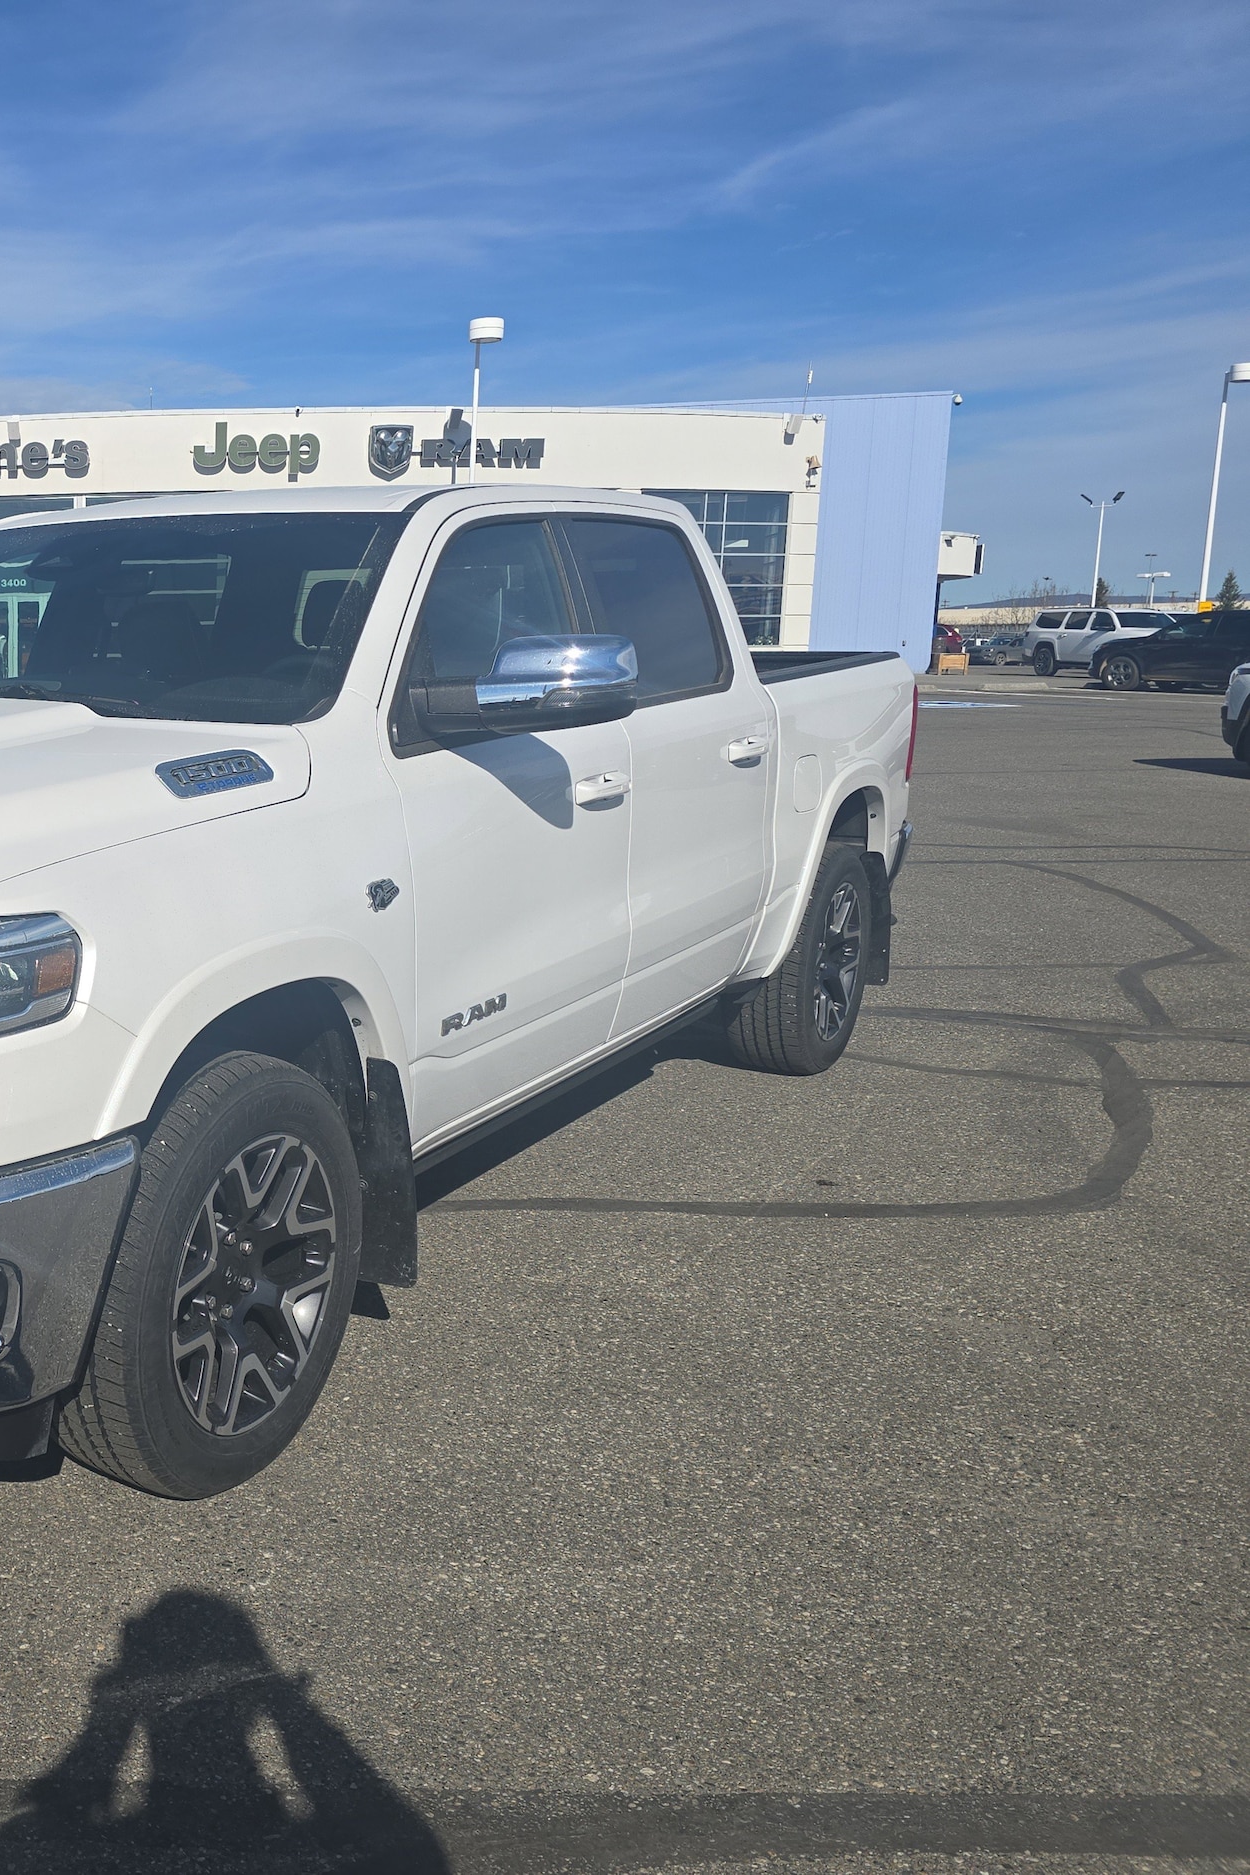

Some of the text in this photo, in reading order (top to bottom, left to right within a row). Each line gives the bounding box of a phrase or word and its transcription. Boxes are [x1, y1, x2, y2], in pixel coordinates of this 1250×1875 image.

[192, 422, 321, 474] Jeep
[421, 438, 545, 460] RAM
[0, 578, 27, 588] 3400
[170, 754, 259, 786] 1500
[440, 992, 507, 1037] RAM
